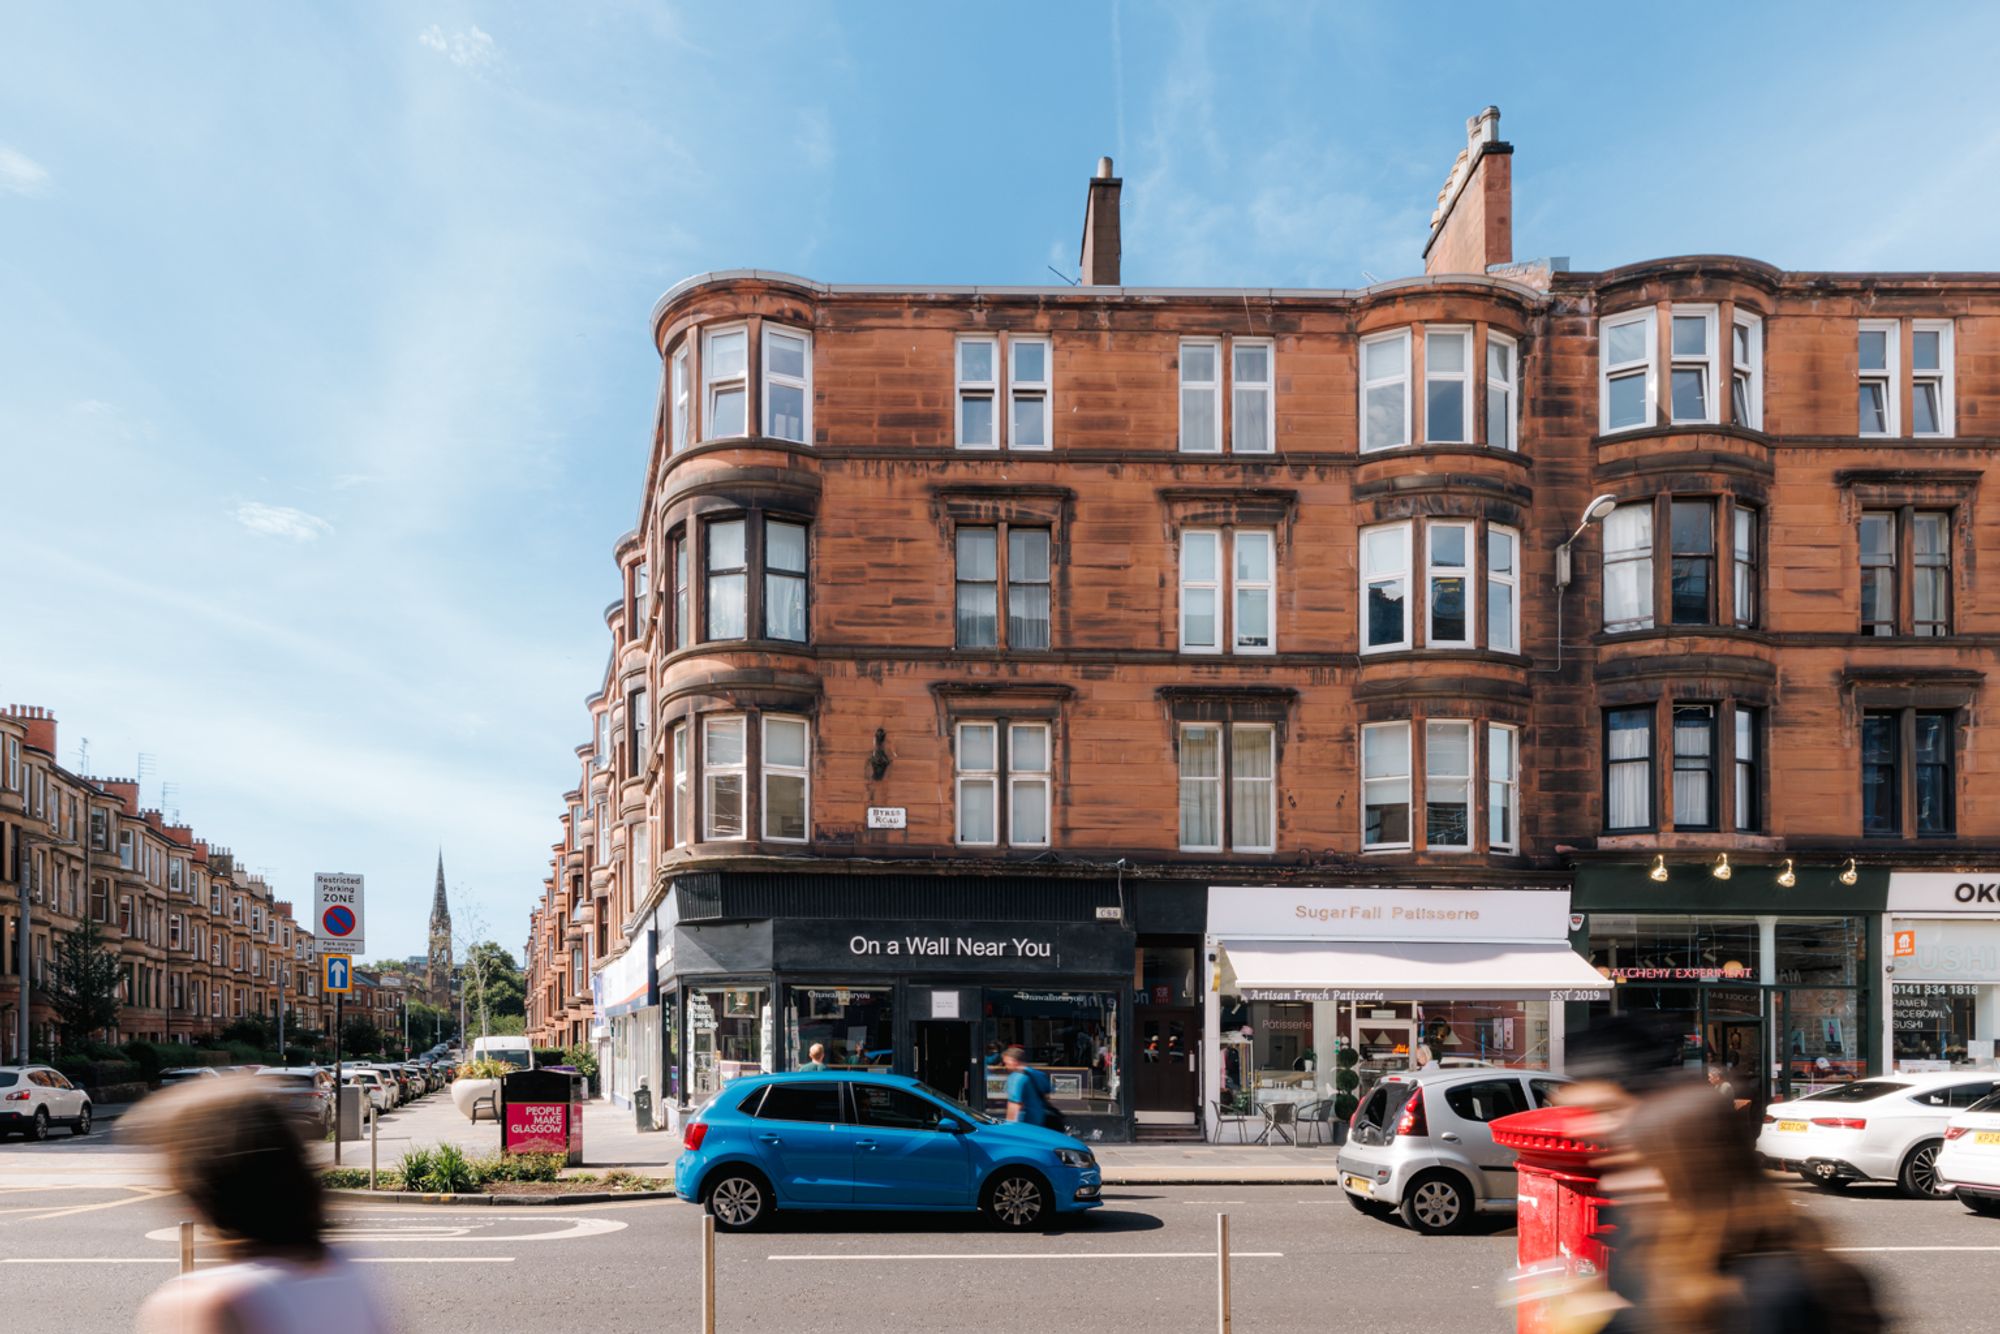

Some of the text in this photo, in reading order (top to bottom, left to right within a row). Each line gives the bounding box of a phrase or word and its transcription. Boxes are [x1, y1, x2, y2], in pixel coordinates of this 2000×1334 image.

[875, 816, 899, 824] ROAD
[317, 876, 361, 885] Restricted
[323, 885, 355, 893] Parking
[1955, 883, 2000, 902] OK
[323, 894, 355, 903] ZONE
[1391, 907, 1480, 920] Patisserie
[850, 936, 1051, 957] On a Wall Near You
[1611, 968, 1670, 978] ALCHEMY
[1675, 968, 1753, 979] EXPERIMENT
[1250, 988, 1600, 1001] Artisan French Patisserie EST 2019
[1893, 984, 1978, 995] 0141 334 1818
[1893, 999, 1928, 1007] RAMEN
[1893, 1021, 1923, 1029] SUSHI
[525, 1106, 562, 1116] PEOPLE
[533, 1115, 562, 1125] MAKE
[511, 1124, 562, 1134] GLASGOW
